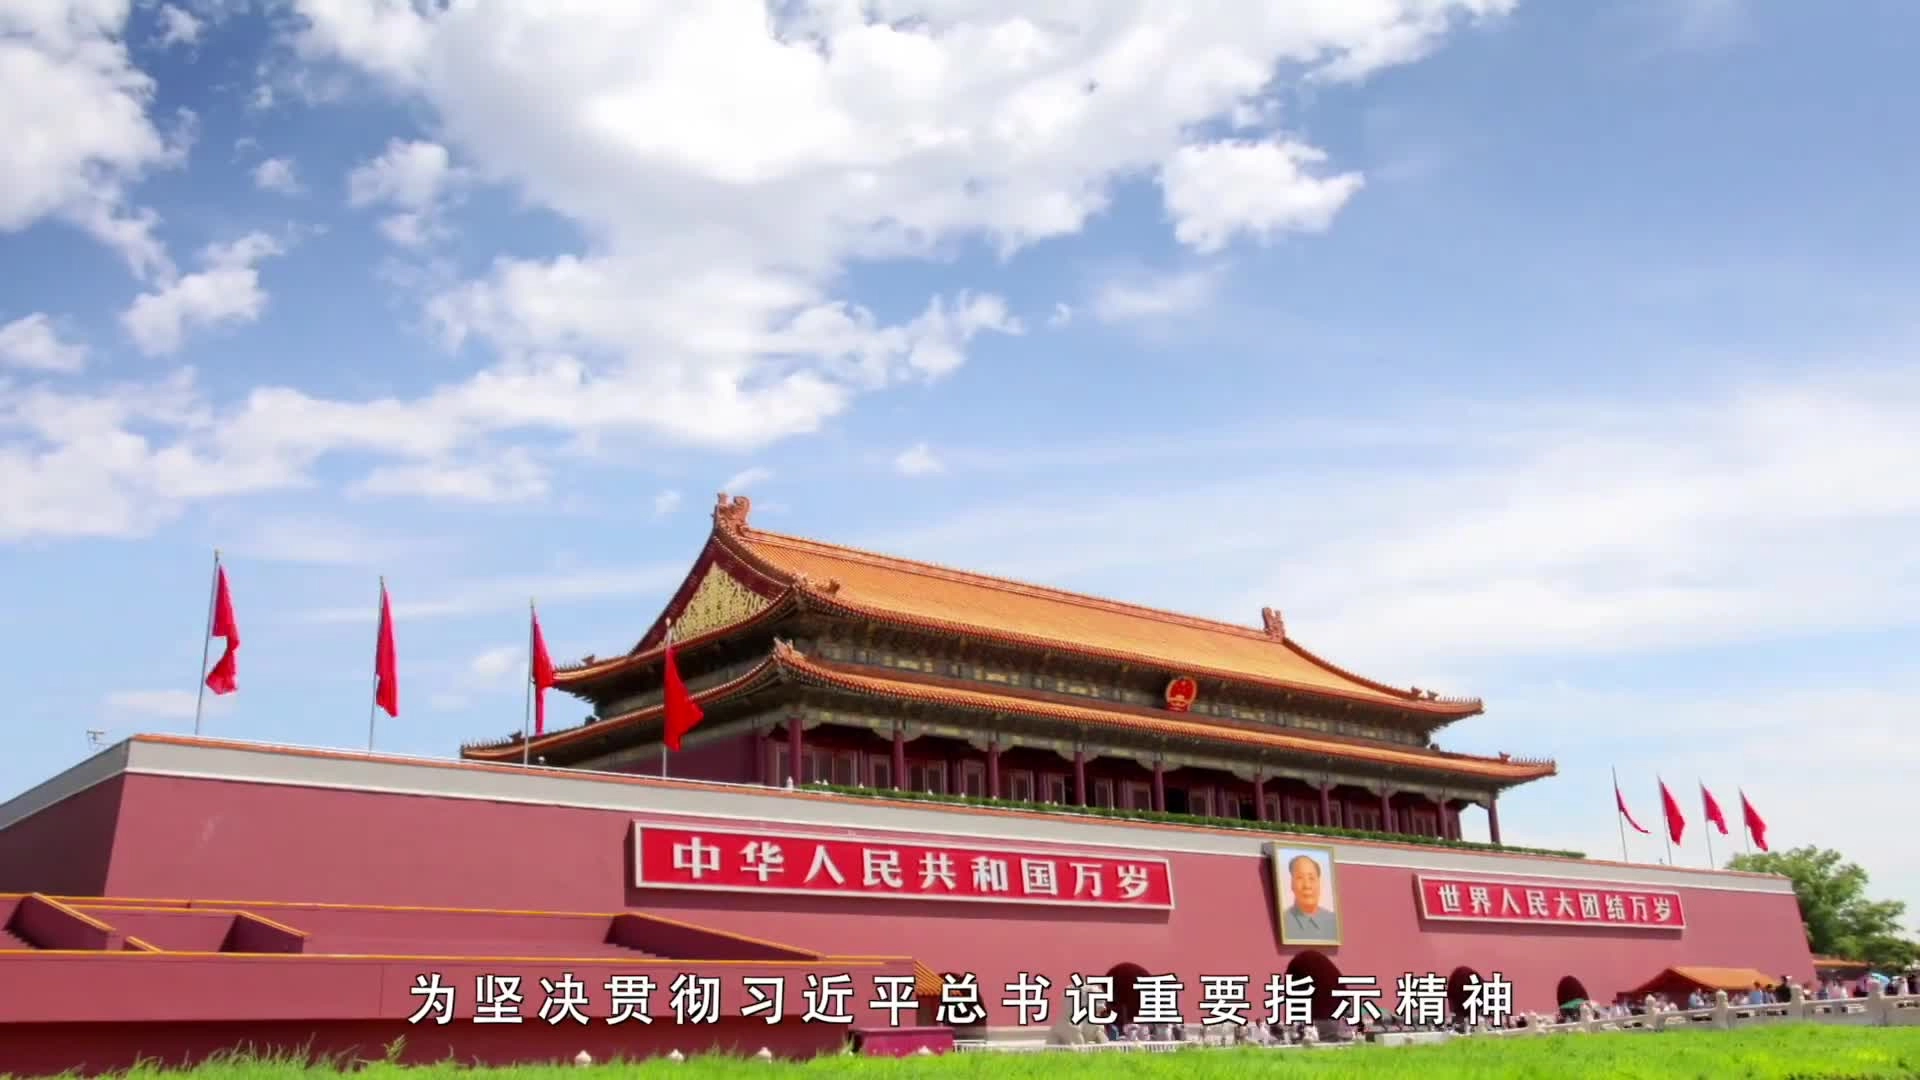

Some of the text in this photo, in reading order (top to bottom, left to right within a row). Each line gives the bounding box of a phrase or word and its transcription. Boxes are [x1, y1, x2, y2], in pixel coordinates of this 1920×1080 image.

[673, 837, 1149, 898] 中华人民共和国万岁
[1438, 884, 1672, 922] 世界人民大团结万岁
